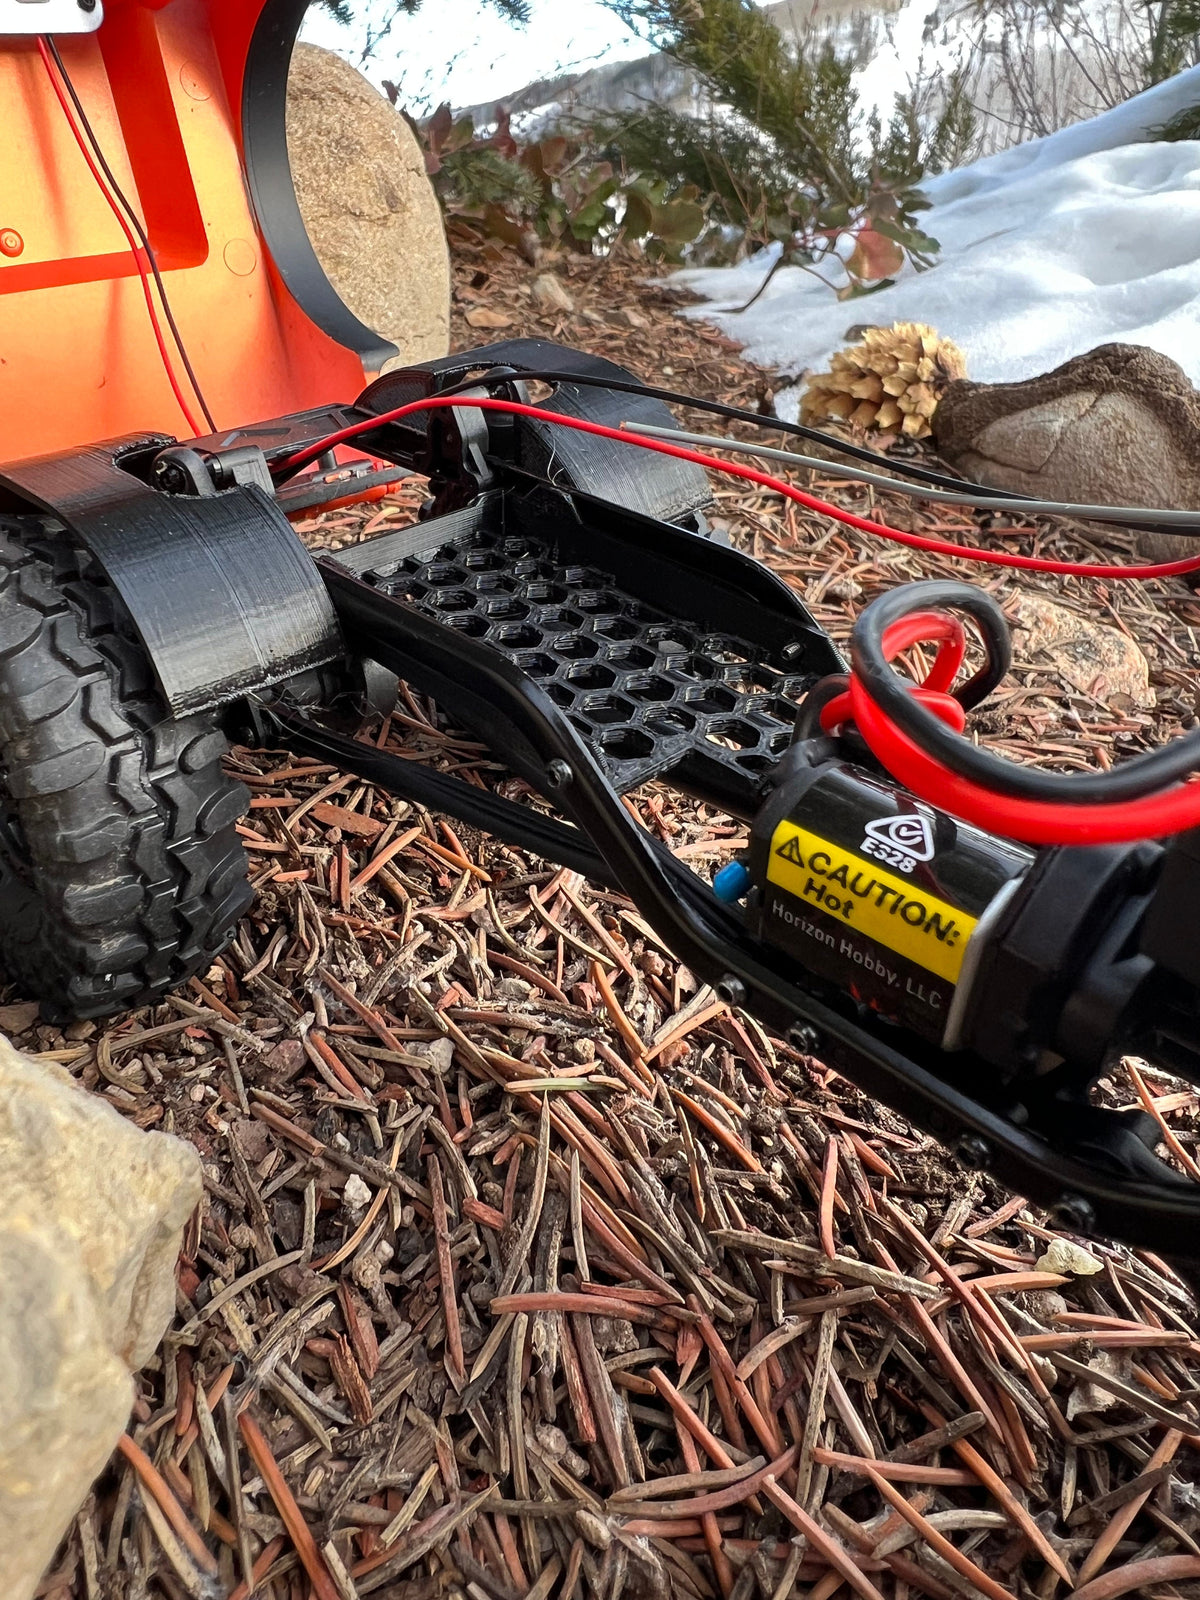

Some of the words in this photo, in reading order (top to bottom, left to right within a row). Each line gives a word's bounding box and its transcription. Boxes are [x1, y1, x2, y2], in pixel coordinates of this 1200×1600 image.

[803, 878, 855, 919] Hot
[808, 852, 961, 947] CAUTION:
[772, 900, 836, 949] Horizon
[839, 939, 901, 988] Hobby,
[906, 977, 942, 1009] LLC
